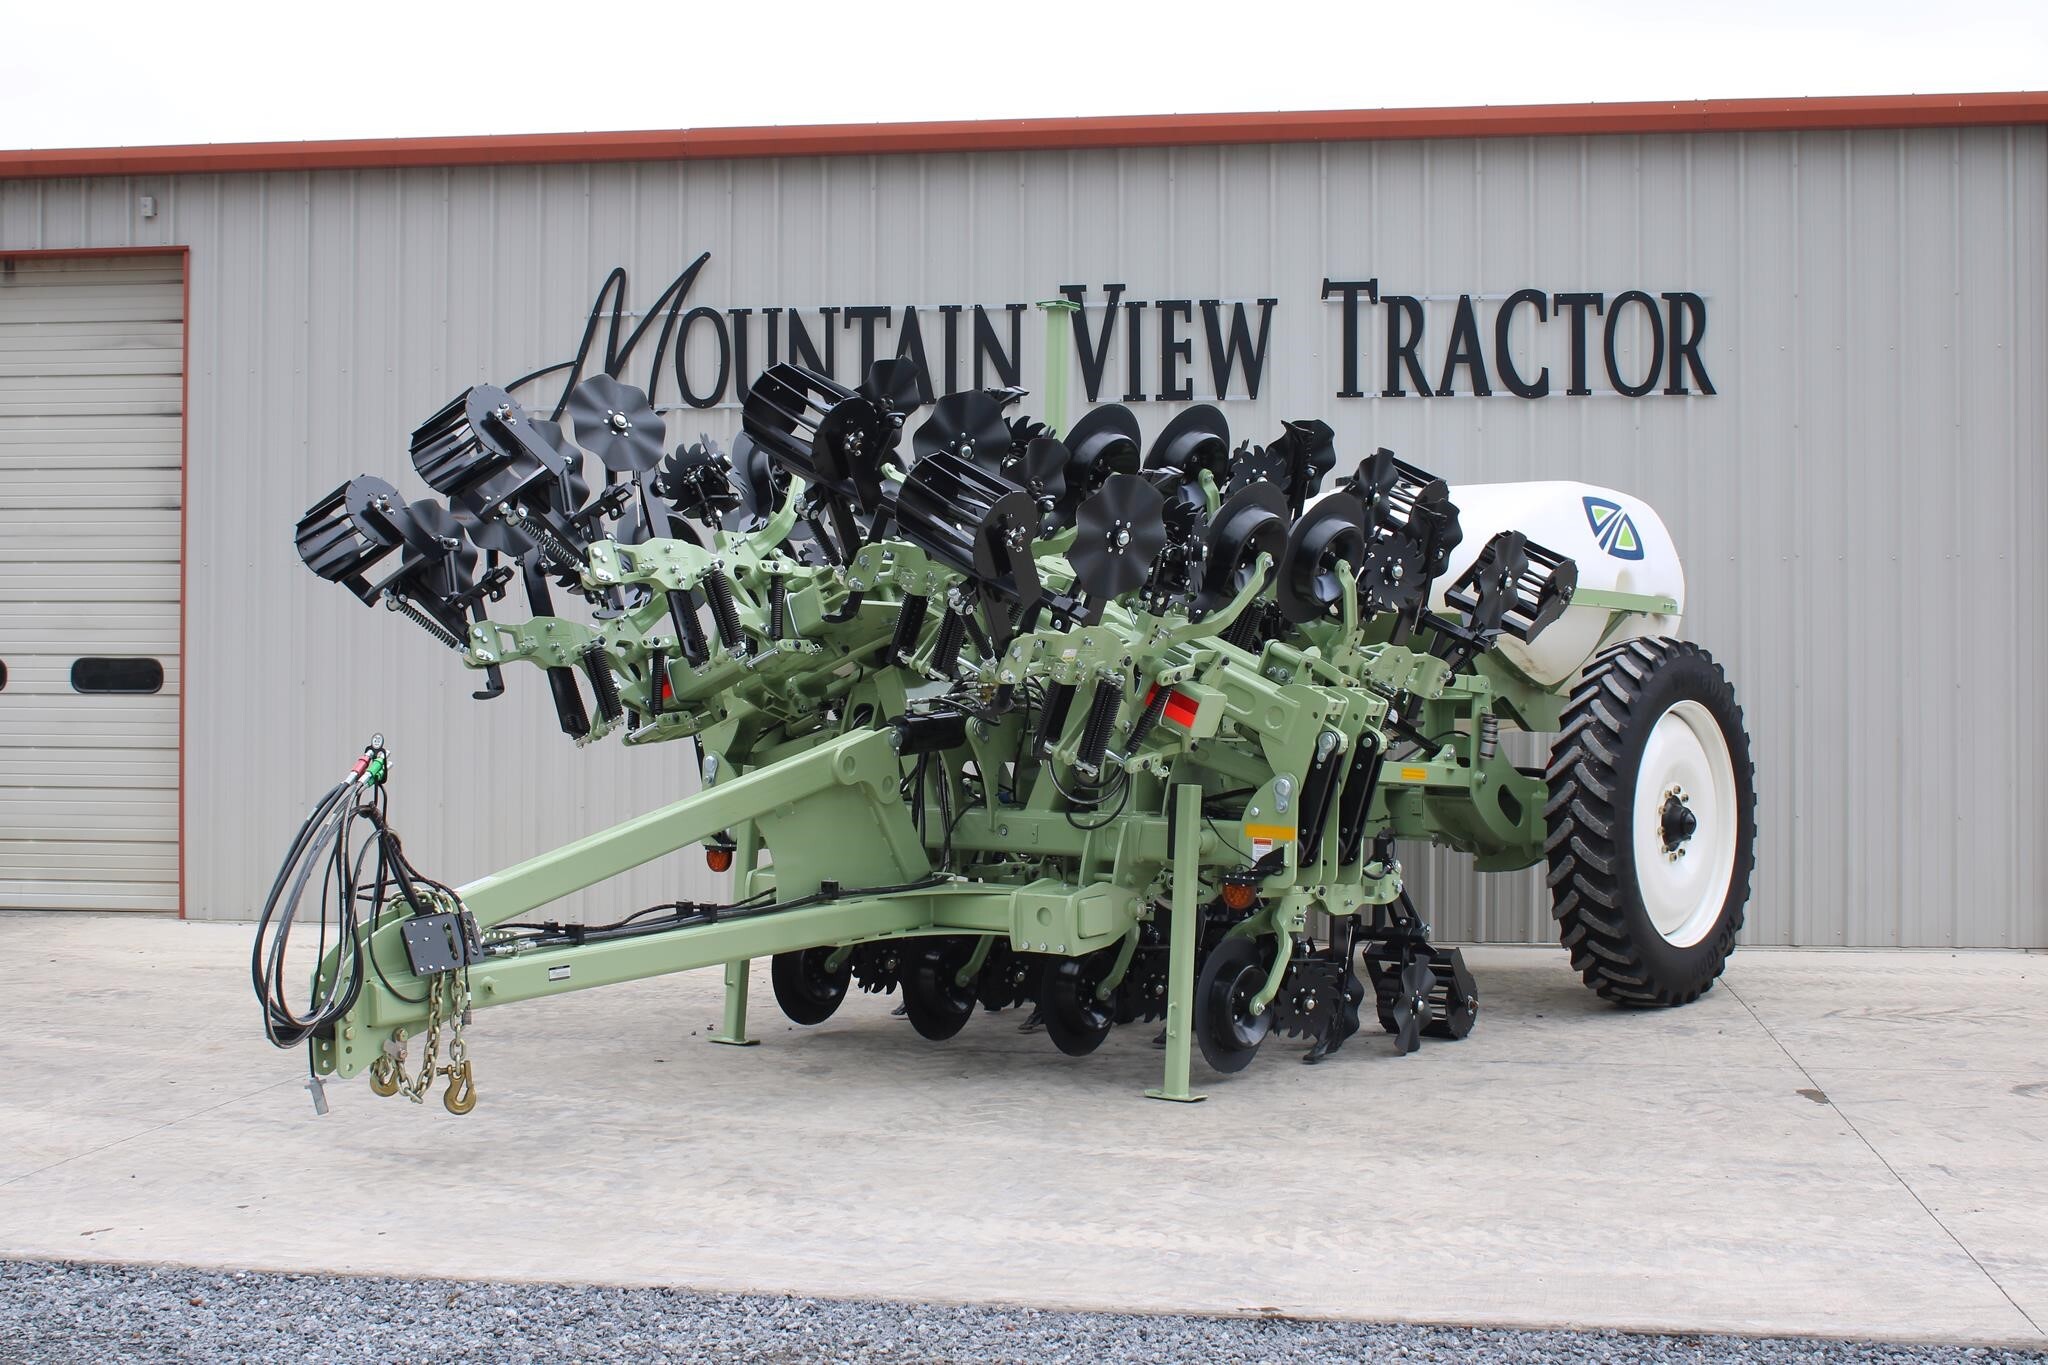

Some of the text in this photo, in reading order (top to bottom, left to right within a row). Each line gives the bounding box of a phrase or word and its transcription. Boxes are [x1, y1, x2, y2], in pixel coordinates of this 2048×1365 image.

[505, 252, 1717, 421] MOUNTAIN VIEW TRACTOR
